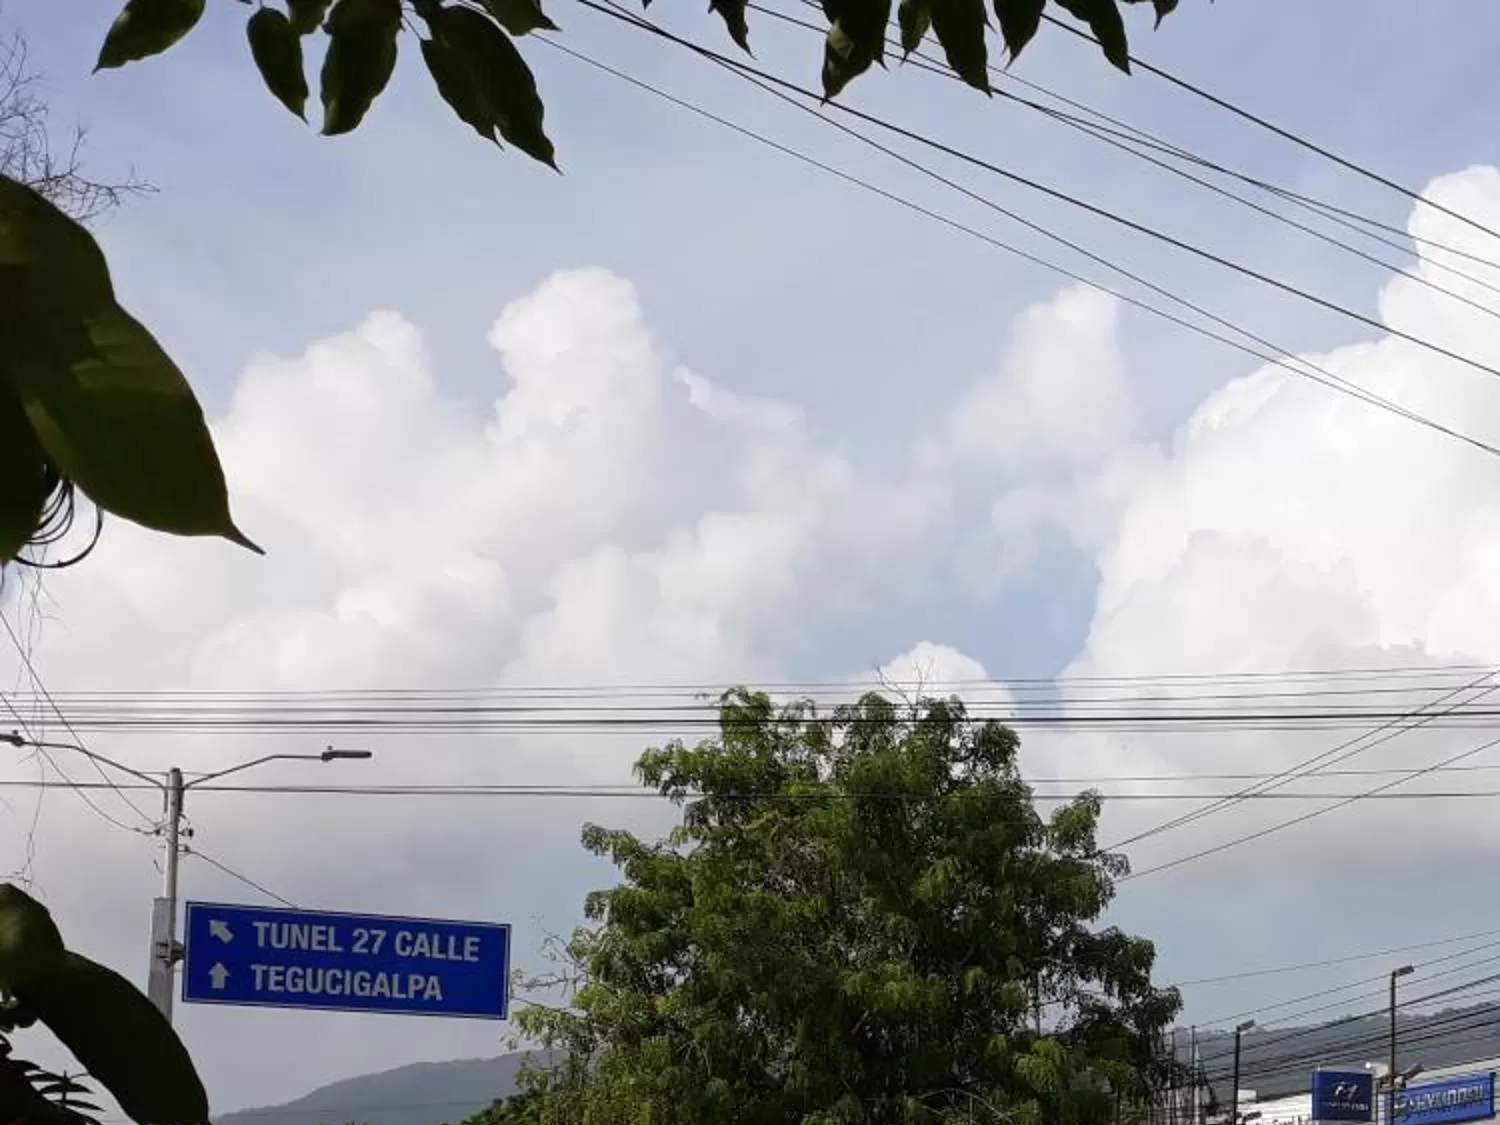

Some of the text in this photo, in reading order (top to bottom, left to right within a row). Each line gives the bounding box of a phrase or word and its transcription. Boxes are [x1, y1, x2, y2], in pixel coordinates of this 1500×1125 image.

[252, 921, 481, 962] TUNEL 27 CALLE
[250, 963, 443, 1001] TEGUCIGALPA
